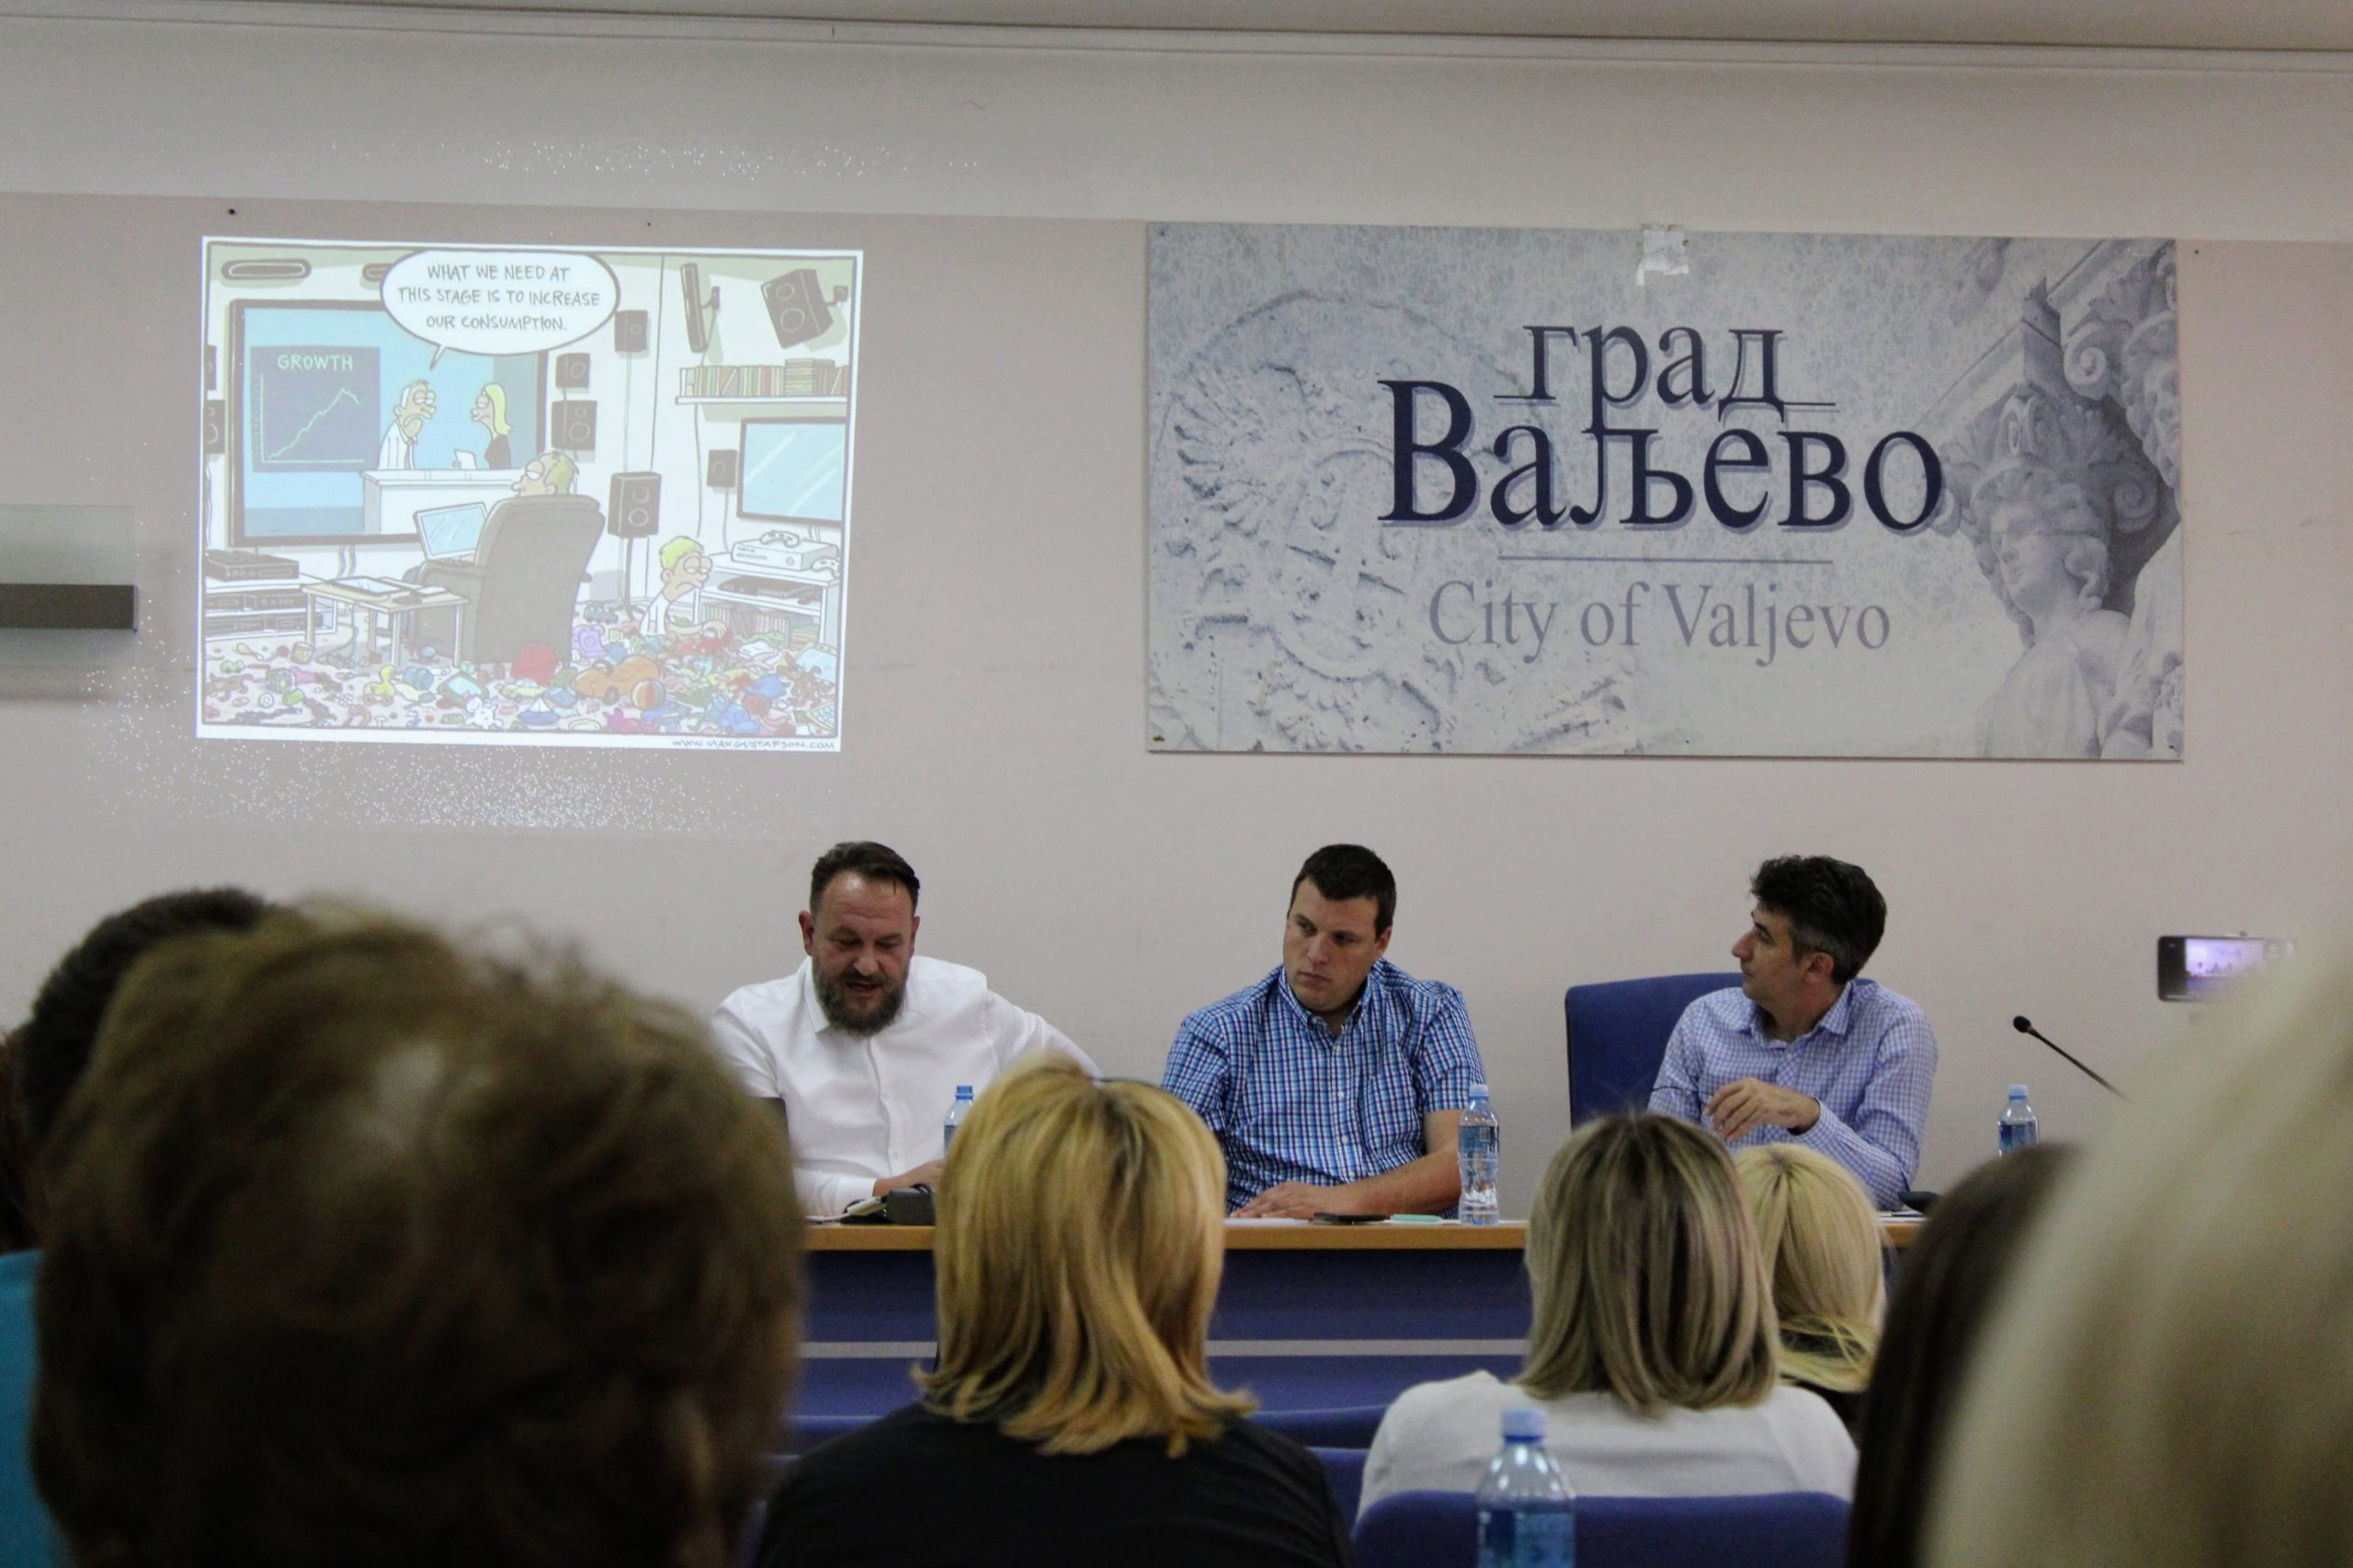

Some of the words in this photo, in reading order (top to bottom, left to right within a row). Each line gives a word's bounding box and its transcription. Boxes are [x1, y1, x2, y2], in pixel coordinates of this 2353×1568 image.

[427, 264, 471, 281] WHAT
[476, 265, 498, 280] WE
[505, 265, 545, 281] NEED
[550, 267, 571, 282] AT
[398, 287, 431, 302] THIS
[437, 288, 481, 304] STAGE
[487, 290, 501, 304] IS
[506, 290, 525, 304] TO
[529, 290, 600, 307] INCREASE
[426, 315, 455, 331] OUR
[461, 314, 567, 332] CONSUMPTION.
[278, 354, 353, 371] GROWTH
[1522, 324, 1786, 433] град
[1377, 378, 1949, 533] Ваљево
[1429, 579, 1559, 664] City
[1580, 580, 1651, 647] of
[1661, 583, 1891, 666] Valjevo
